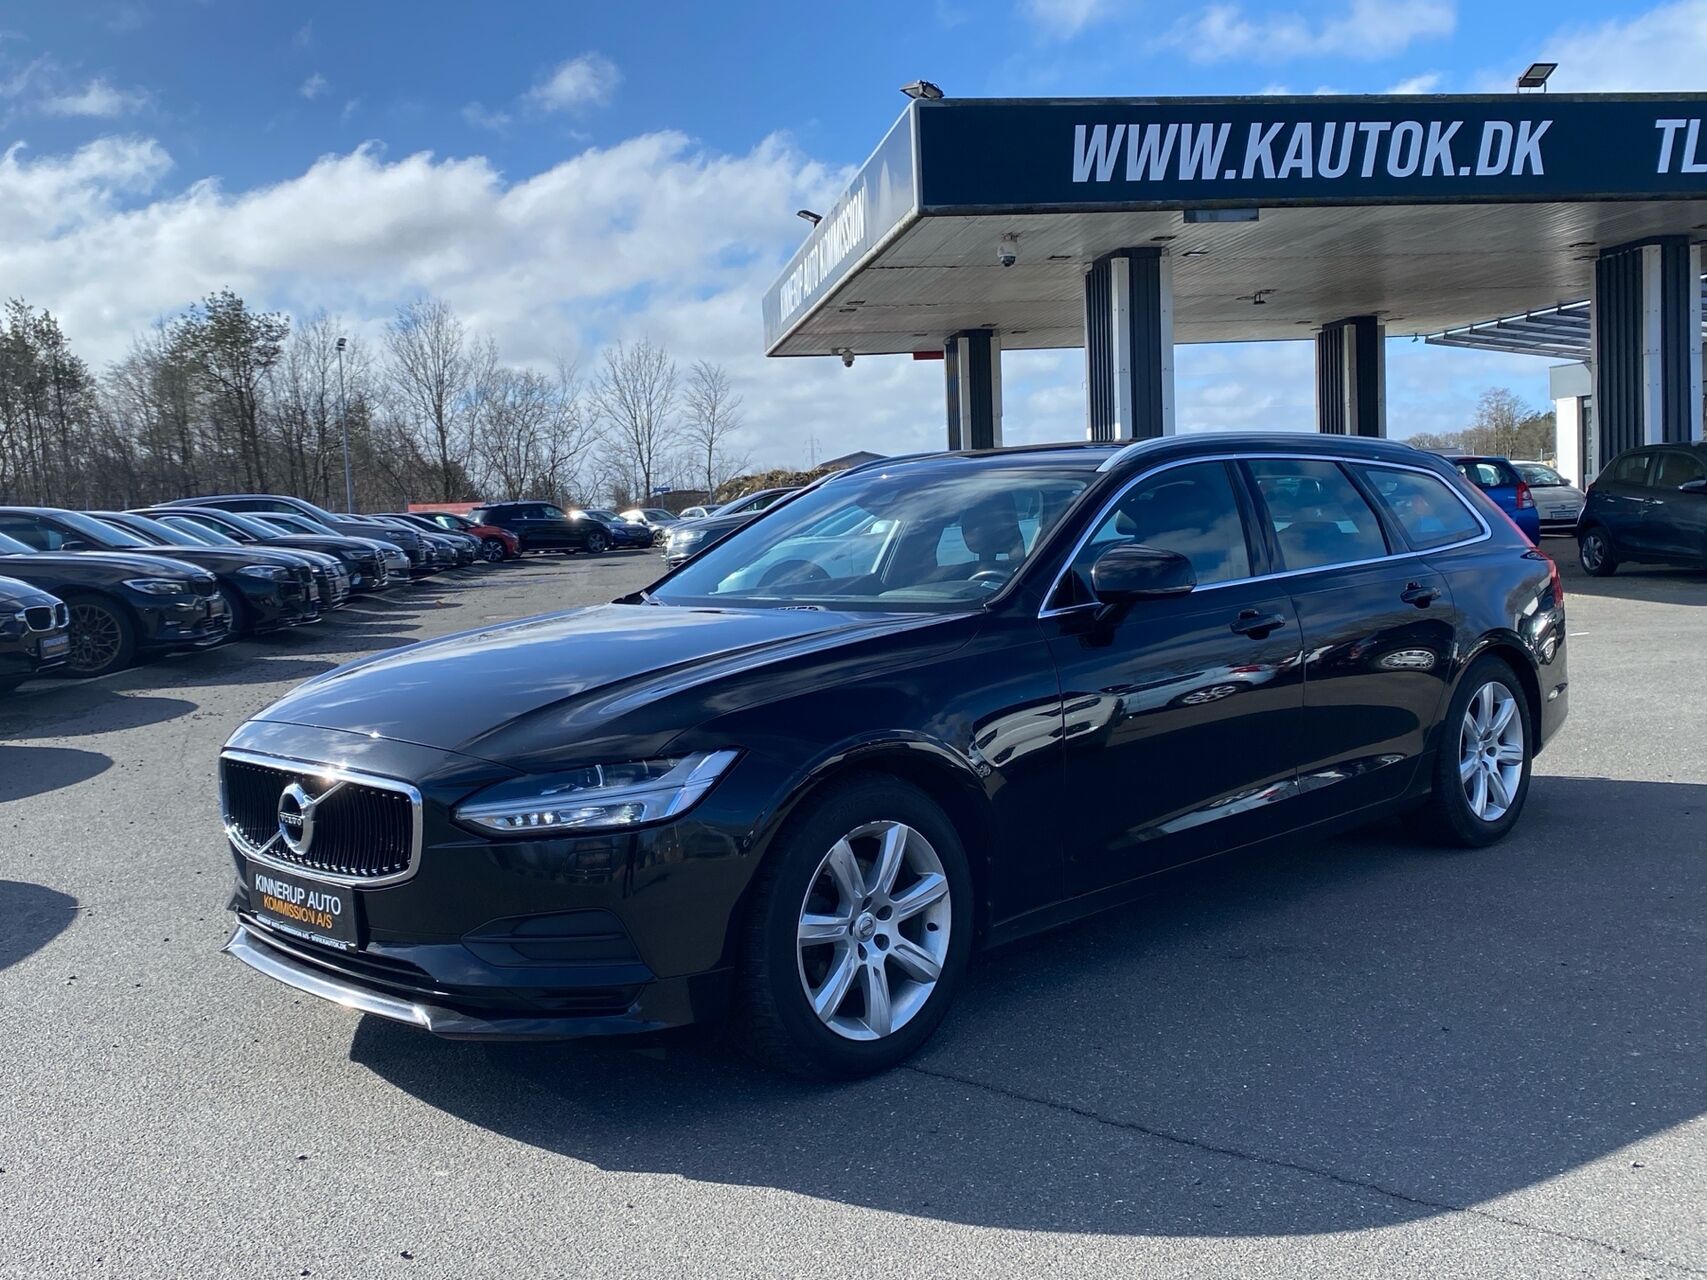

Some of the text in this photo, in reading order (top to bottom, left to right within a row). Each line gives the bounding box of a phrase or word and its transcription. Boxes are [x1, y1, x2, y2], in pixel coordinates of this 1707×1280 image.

[1072, 119, 1554, 183] WWW.KAUTOK.DK
[279, 814, 302, 826] VOLVO
[255, 873, 342, 916] KINNERUP AUTO
[263, 895, 315, 924] KOMMISSION
[316, 912, 333, 929] A/S
